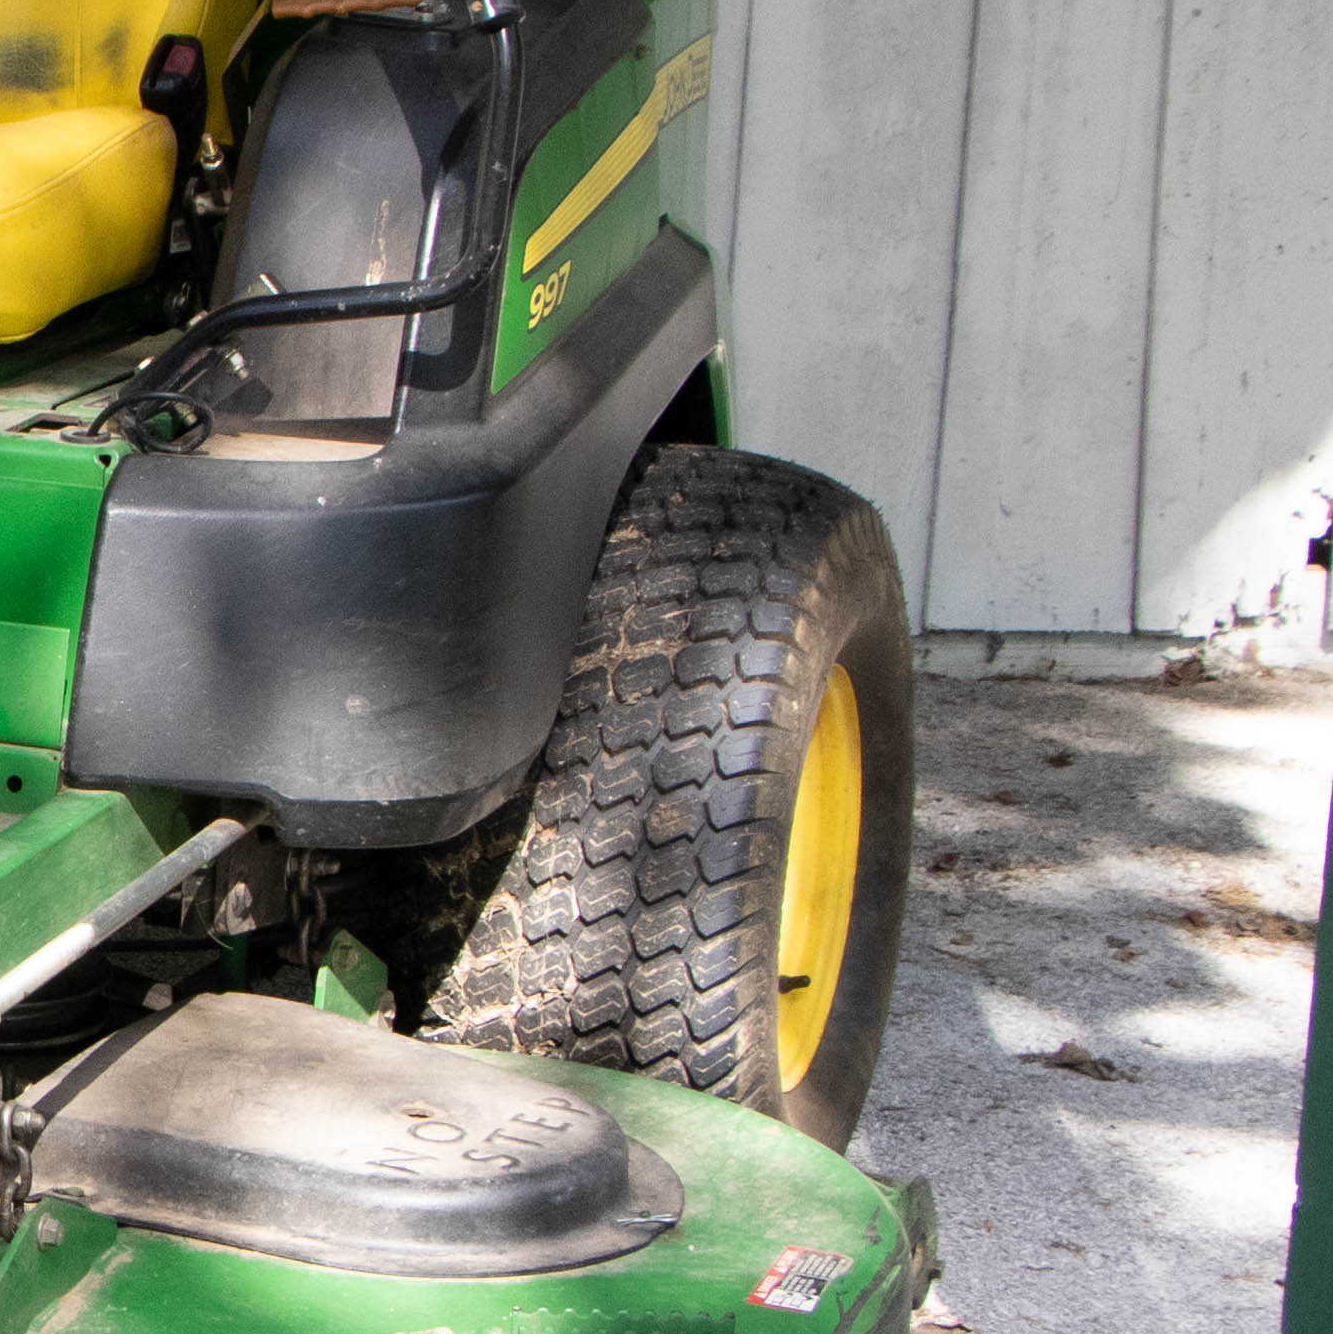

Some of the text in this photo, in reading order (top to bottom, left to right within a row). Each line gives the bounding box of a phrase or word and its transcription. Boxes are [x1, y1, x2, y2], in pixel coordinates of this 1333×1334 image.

[528, 258, 572, 331] 997
[364, 1121, 467, 1175] NO
[461, 1096, 591, 1170] STEP
